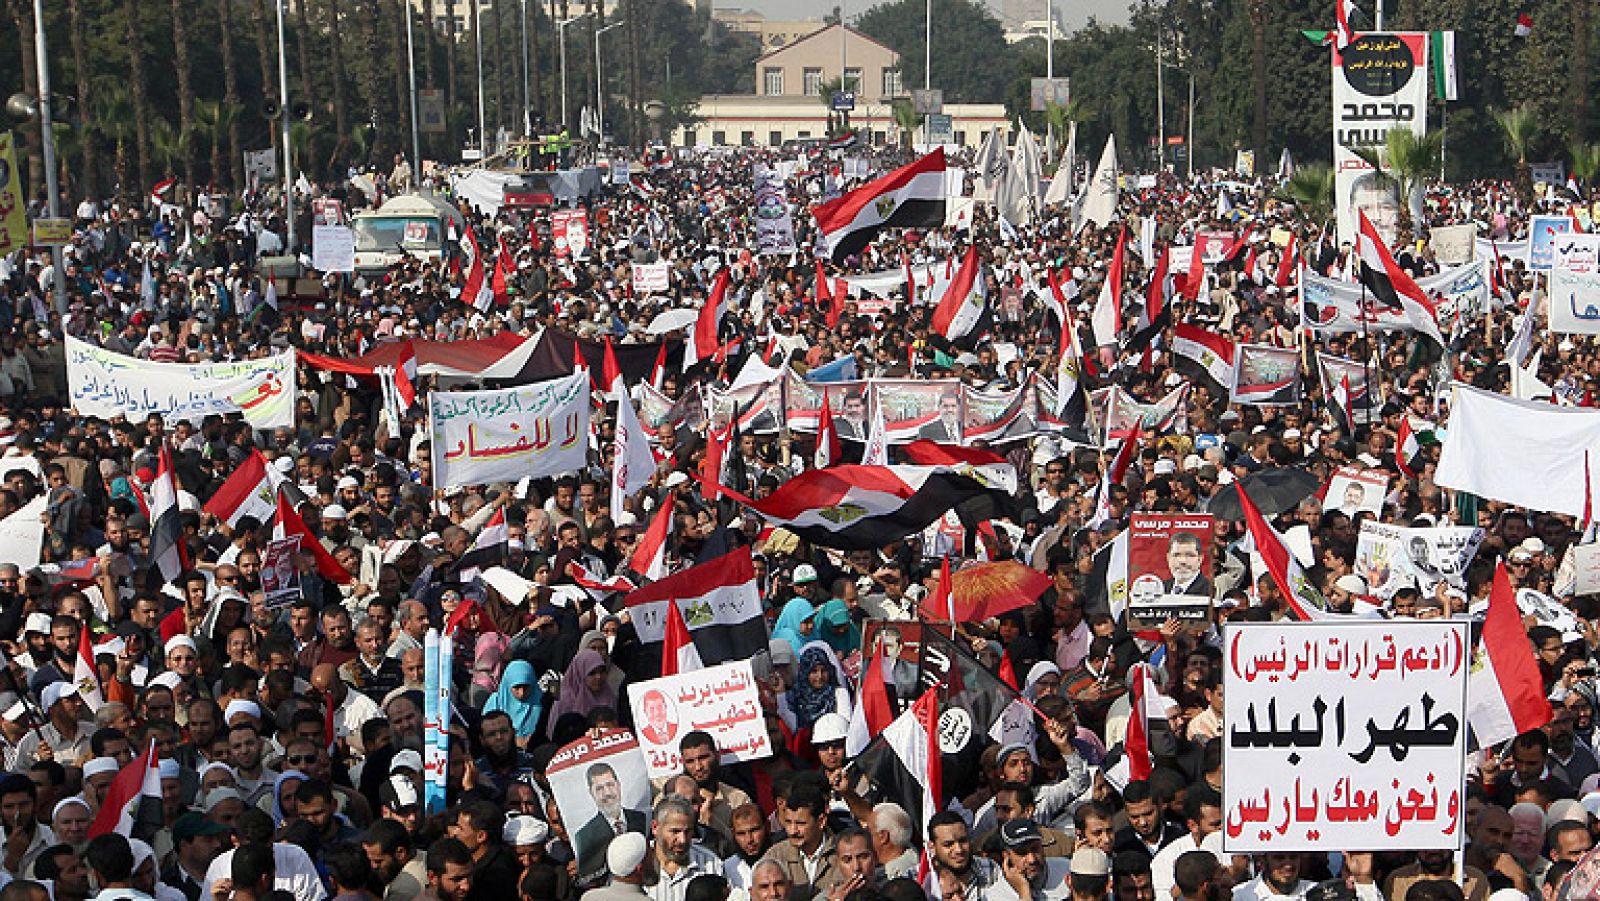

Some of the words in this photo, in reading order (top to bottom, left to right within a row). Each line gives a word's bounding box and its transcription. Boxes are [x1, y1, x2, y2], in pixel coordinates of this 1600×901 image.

[1342, 104, 1414, 121] محمد
[432, 396, 479, 426] السلفية
[481, 391, 521, 419] الدعوة
[444, 416, 551, 460] للفساد
[560, 412, 579, 447] لا
[1325, 635, 1397, 681] قرارات
[679, 684, 711, 707] يريد
[714, 669, 751, 701] الشعب
[692, 700, 757, 732] تطهير
[1231, 695, 1345, 766] البلد
[1348, 691, 1459, 764] طهر
[593, 732, 633, 751] محمد
[1326, 777, 1379, 823] معك
[1385, 772, 1438, 837] نحن
